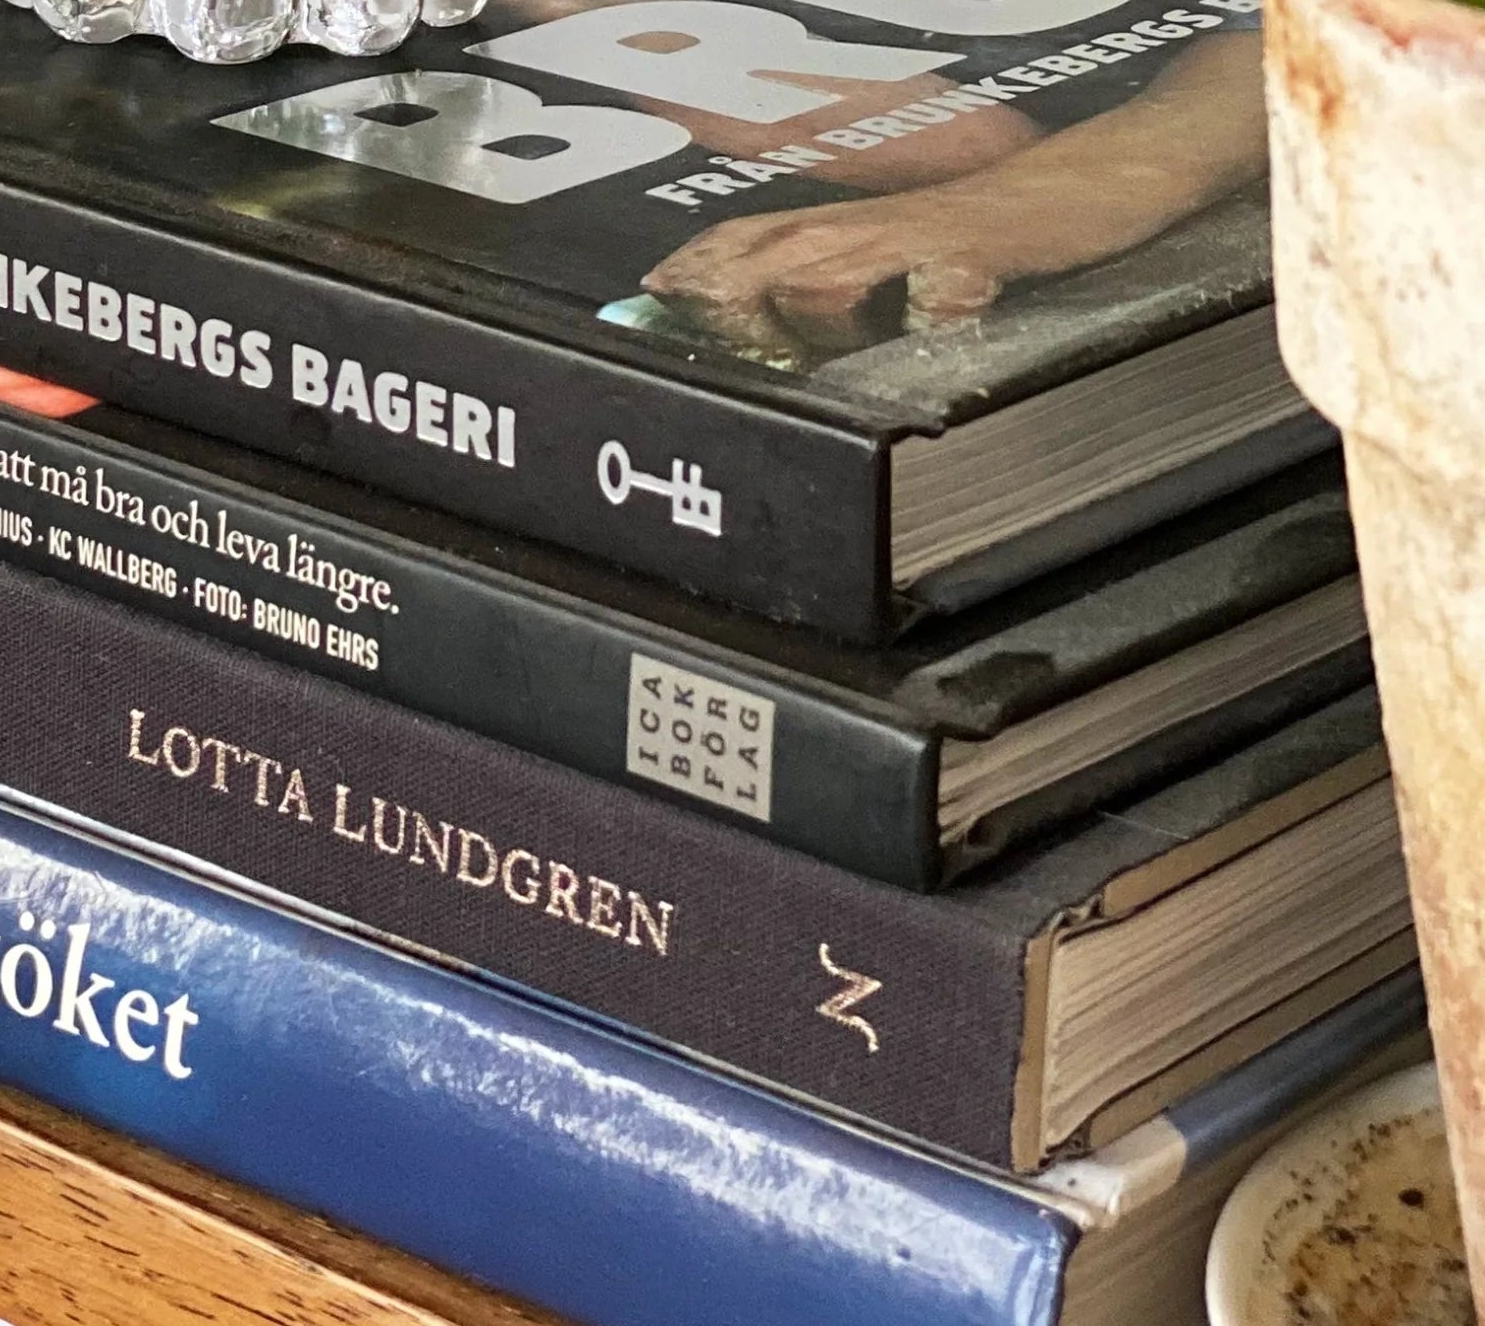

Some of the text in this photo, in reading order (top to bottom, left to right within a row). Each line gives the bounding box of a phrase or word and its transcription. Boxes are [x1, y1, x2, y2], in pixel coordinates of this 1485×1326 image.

[645, 8, 1223, 206] FRÅN BRUNKEBERGS
[291, 343, 516, 468] BAGERI
[40, 460, 89, 507] må
[94, 468, 145, 525] bra
[151, 498, 210, 548] och
[215, 510, 280, 573] leva
[285, 533, 400, 615] längre.
[48, 527, 72, 561] KC
[77, 536, 176, 598] WALLBERG
[193, 578, 247, 621] FOTO:
[253, 599, 320, 650] BRUNO
[326, 624, 379, 672] EHRS
[638, 676, 662, 766] ICA
[670, 683, 695, 779] BOK
[700, 696, 728, 791] FÖR
[736, 705, 760, 802] LAG
[129, 708, 674, 955] LOTTA LUNDGREN
